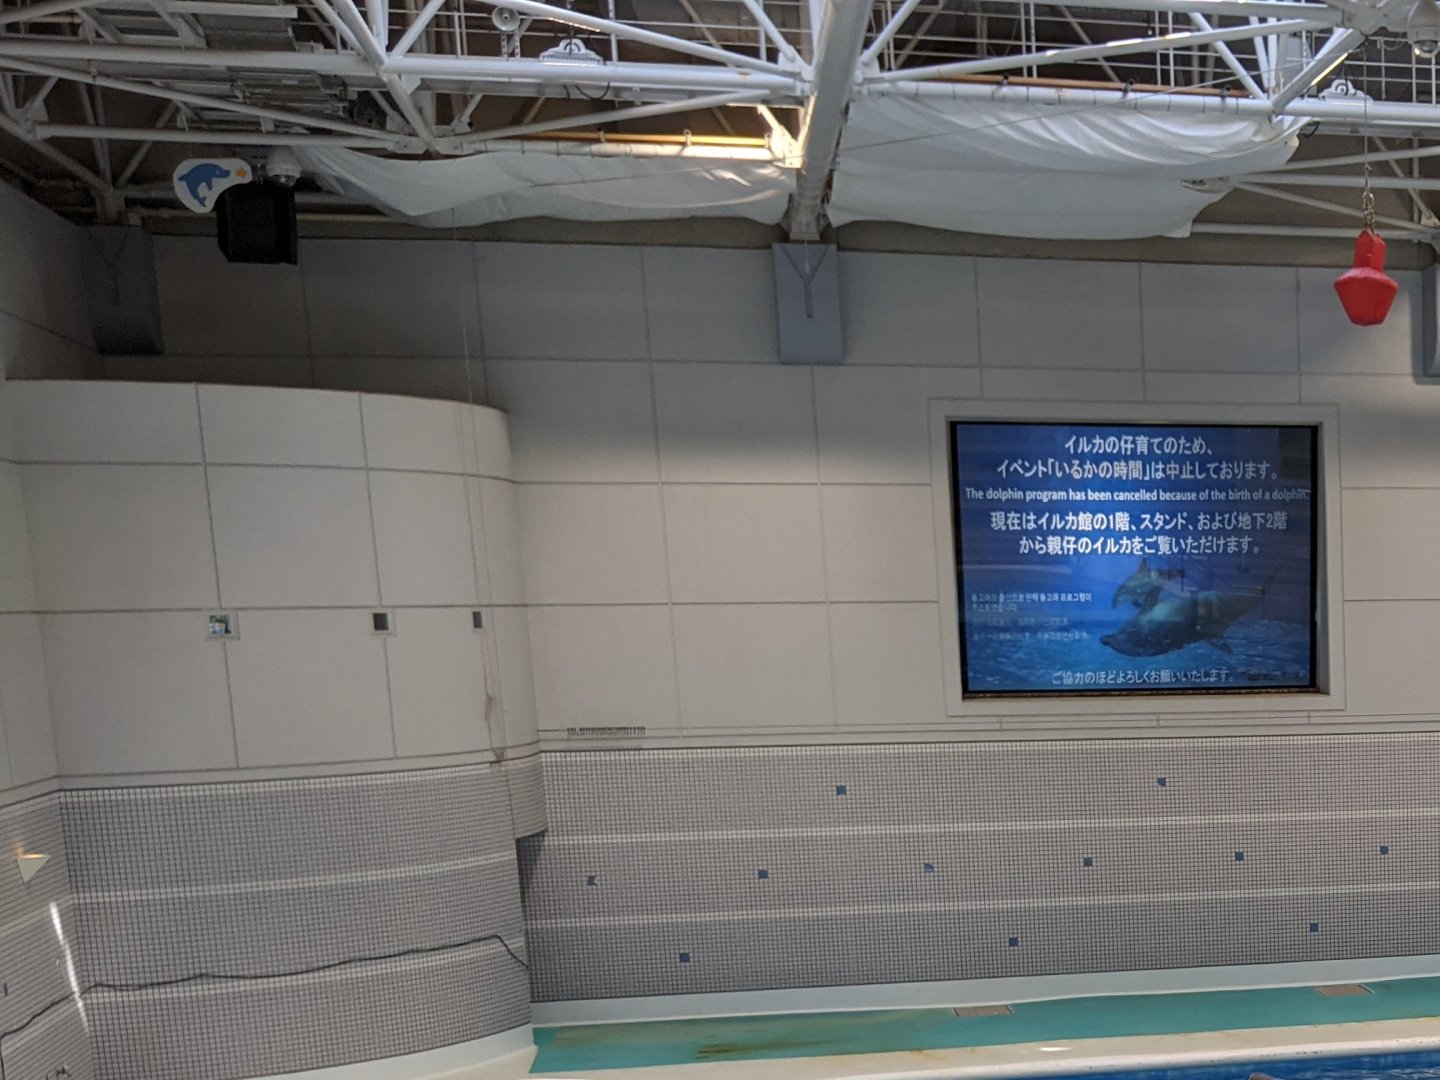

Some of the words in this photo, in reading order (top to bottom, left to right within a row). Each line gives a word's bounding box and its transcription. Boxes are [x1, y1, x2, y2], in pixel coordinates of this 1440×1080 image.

[1064, 434, 1214, 456] イルカの仔育てのため、
[996, 458, 1279, 480] イベント「いるかの時間」は中止しております。
[965, 488, 984, 500] The
[985, 488, 1023, 504] dolphin
[1025, 490, 1067, 503] program
[1068, 489, 1086, 501] has
[1087, 489, 1112, 501] been
[1113, 489, 1158, 501] cancelled
[1159, 489, 1197, 501] because
[1199, 489, 1210, 501] of
[1210, 489, 1227, 501] the
[1228, 489, 1251, 501] birth
[1252, 489, 1263, 501] of
[1264, 492, 1270, 501] a
[990, 510, 1288, 532] 現在はイルカ館の1階、スタンド、および地下2階
[1019, 535, 1260, 556] から親仔のイルカをご覧いただけます。
